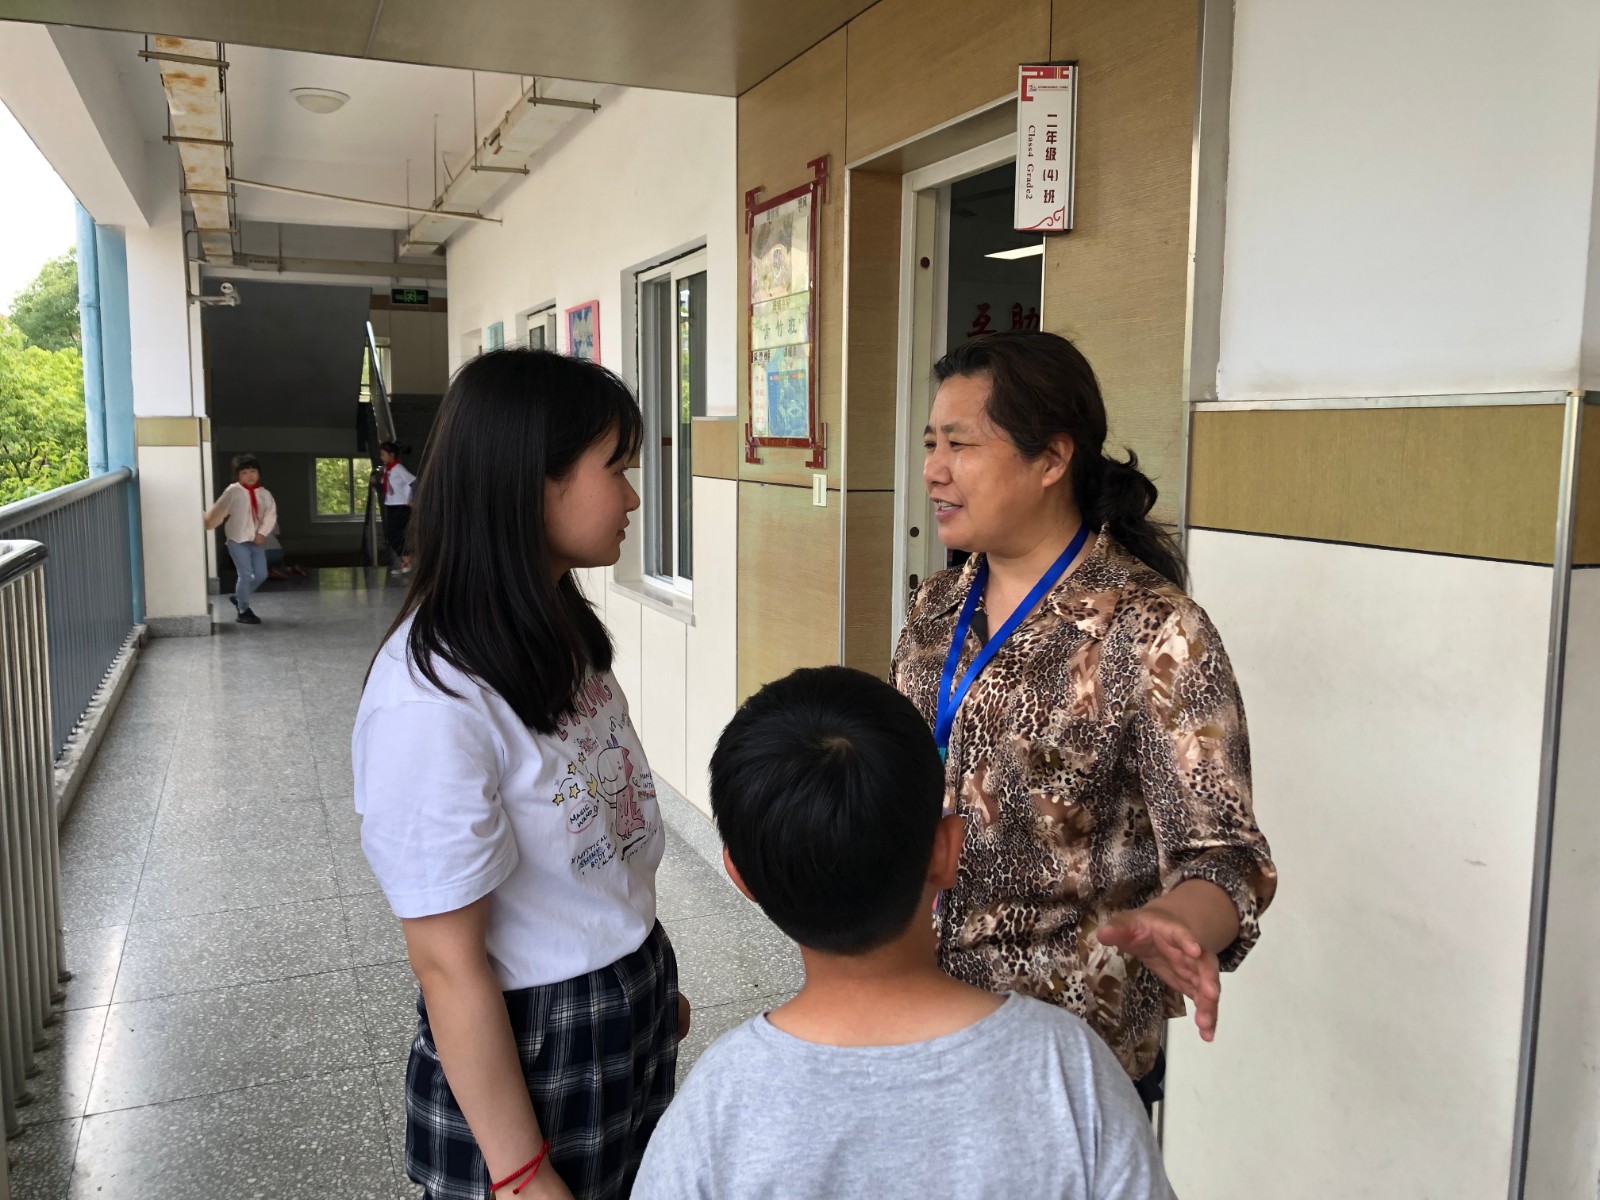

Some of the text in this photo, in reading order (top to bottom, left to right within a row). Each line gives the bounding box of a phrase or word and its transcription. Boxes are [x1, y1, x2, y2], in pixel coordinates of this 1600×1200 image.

[1025, 124, 1036, 200] Class4 Grade2
[1043, 114, 1059, 203] 二年级(4)班
[569, 803, 590, 824] MAGIC
[577, 809, 593, 828] WAND
[590, 848, 606, 869] BODY
